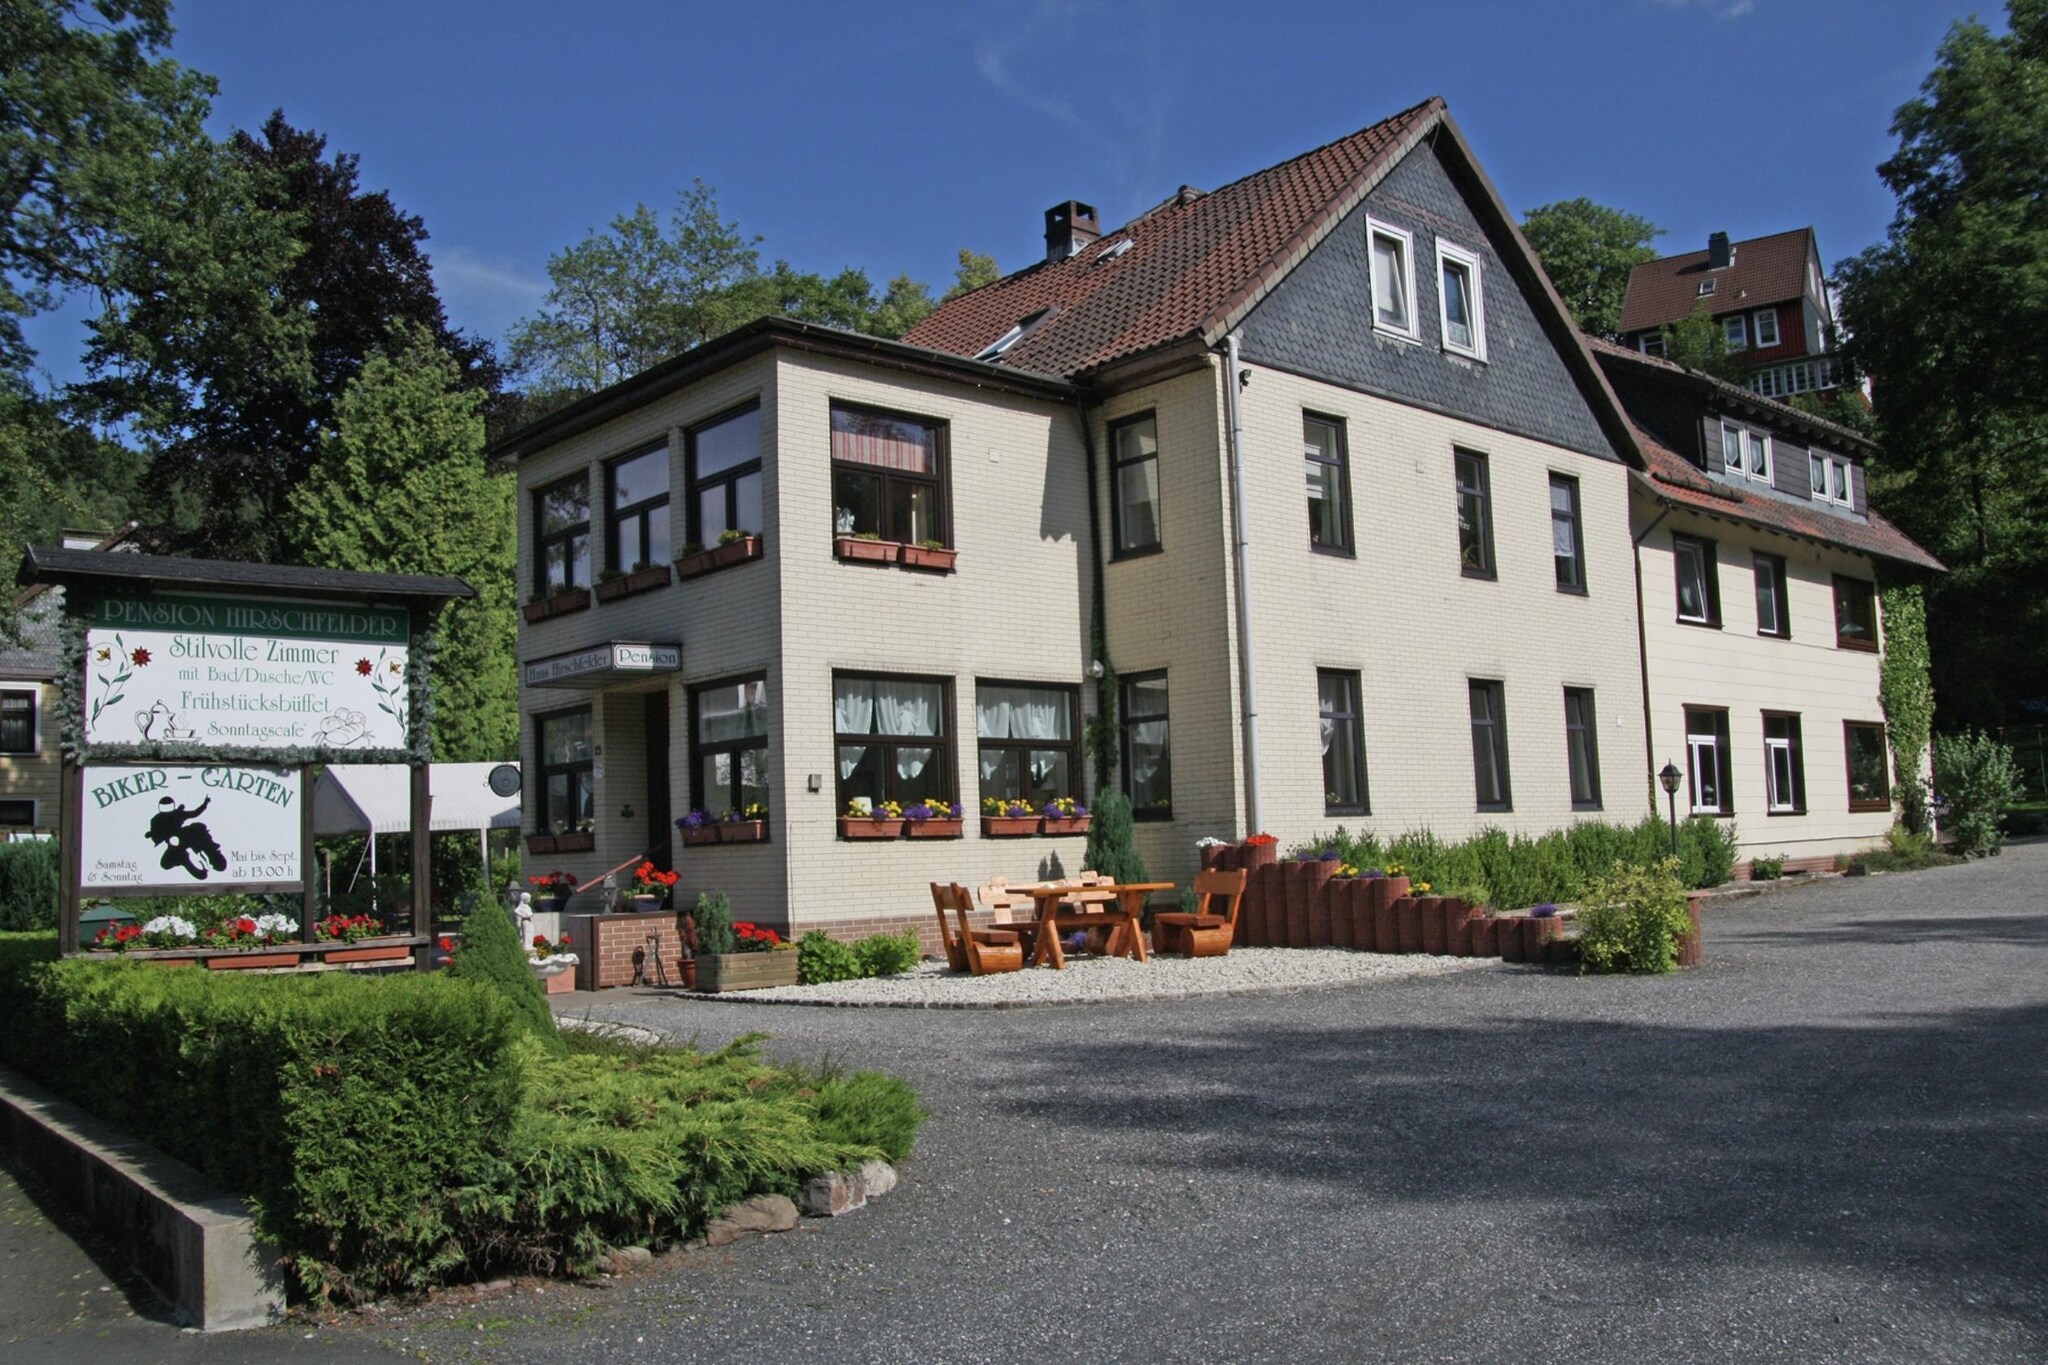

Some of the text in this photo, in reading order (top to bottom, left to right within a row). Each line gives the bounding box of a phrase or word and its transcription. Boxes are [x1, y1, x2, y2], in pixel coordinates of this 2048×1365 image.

[103, 600, 397, 636] PENSION HIRSCHFELDER
[168, 634, 340, 664] Stilvolle Zimmer
[619, 649, 677, 664] Pension
[552, 653, 608, 676] Hirschfelder
[178, 667, 335, 687] mit Bad/Dusche/WC
[180, 691, 332, 714] Frühstücksbüffet
[91, 769, 168, 808] BIKER
[201, 767, 295, 808] GARTEN
[95, 858, 137, 873] Samstag
[230, 849, 298, 866] Mai bis Sept.
[101, 871, 144, 885] Sonntag
[232, 865, 294, 878] ab 13.00 h
